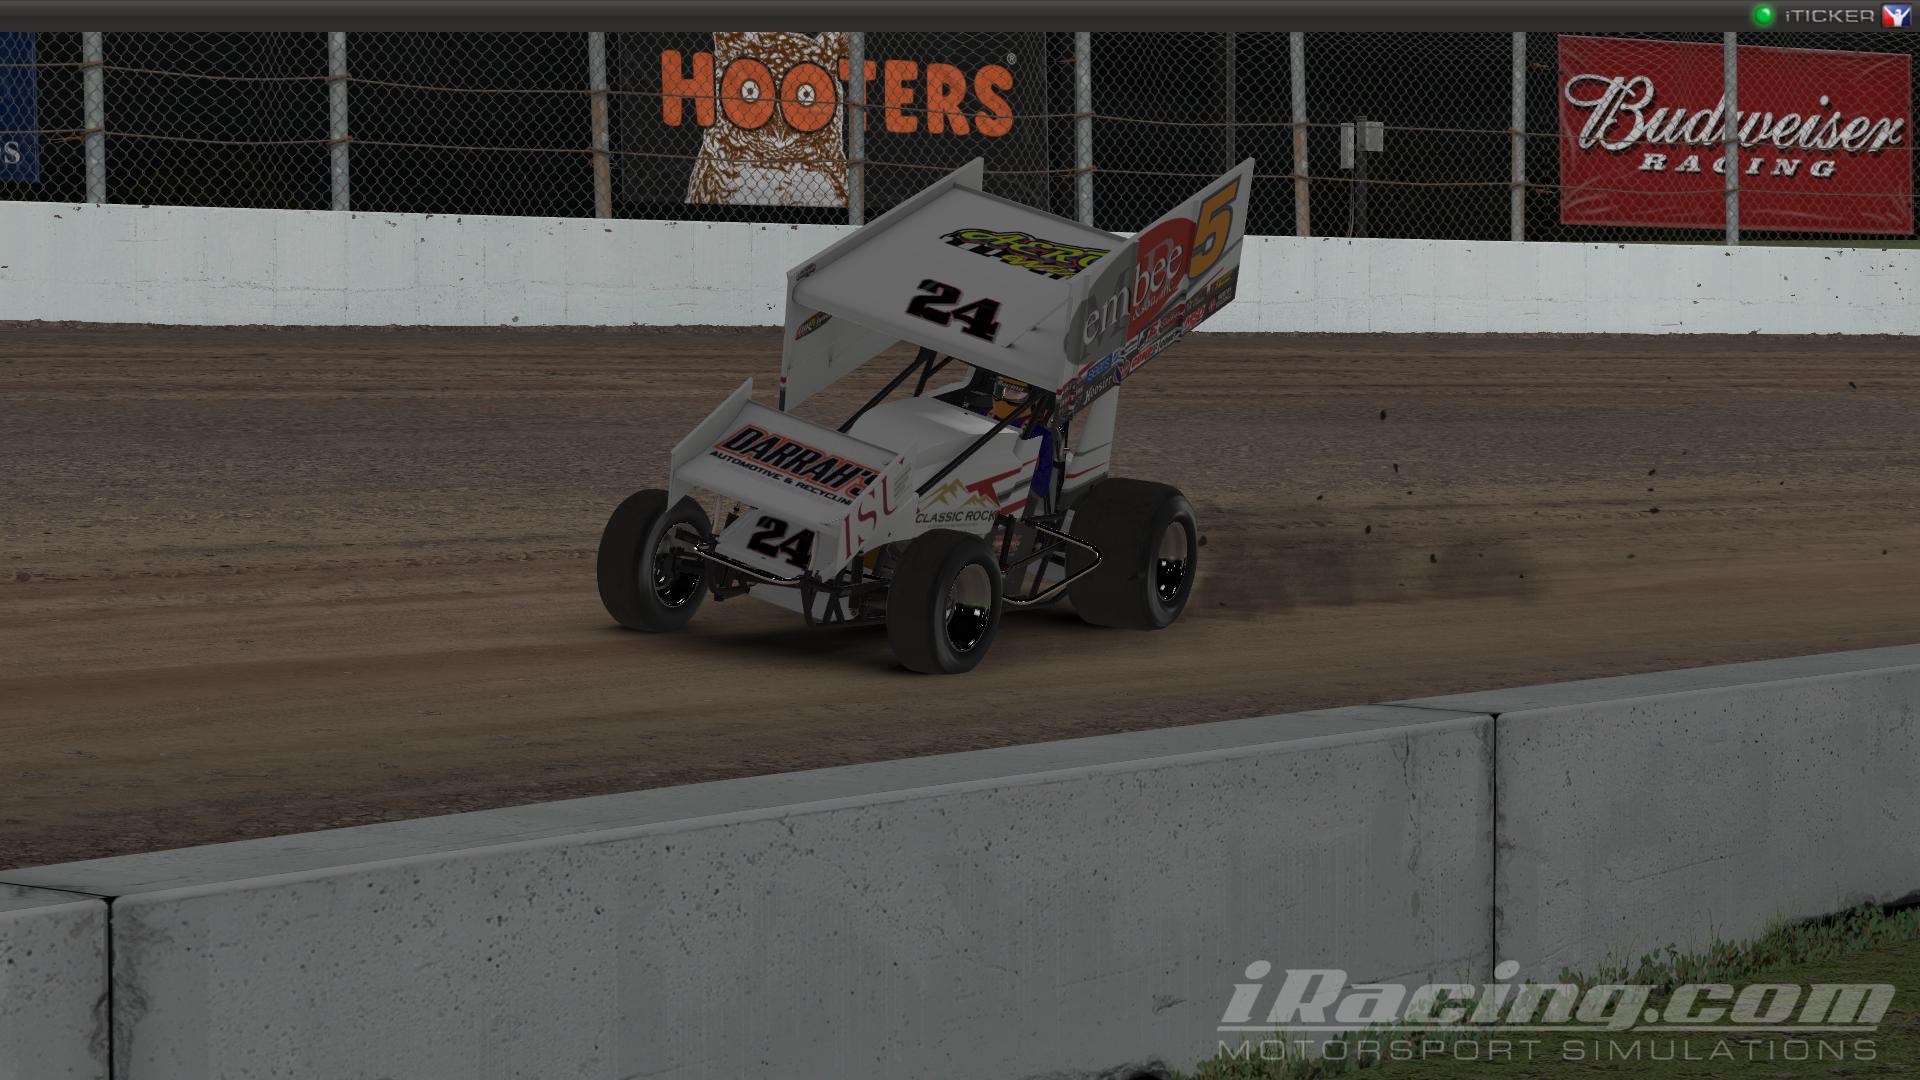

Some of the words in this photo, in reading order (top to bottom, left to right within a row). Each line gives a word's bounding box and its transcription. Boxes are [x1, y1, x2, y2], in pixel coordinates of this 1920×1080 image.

[660, 49, 1014, 138] HOOTERS
[1564, 73, 1905, 152] Budweiser
[1638, 153, 1838, 178] RACING
[1188, 174, 1241, 279] 5
[906, 279, 1001, 343] 24
[1083, 244, 1183, 345] embee
[709, 451, 782, 480] AUTOMOTIVE
[783, 476, 793, 485] &
[716, 424, 880, 498] DARRAH'S
[747, 516, 815, 569] 24
[915, 511, 964, 525] CLASSIC
